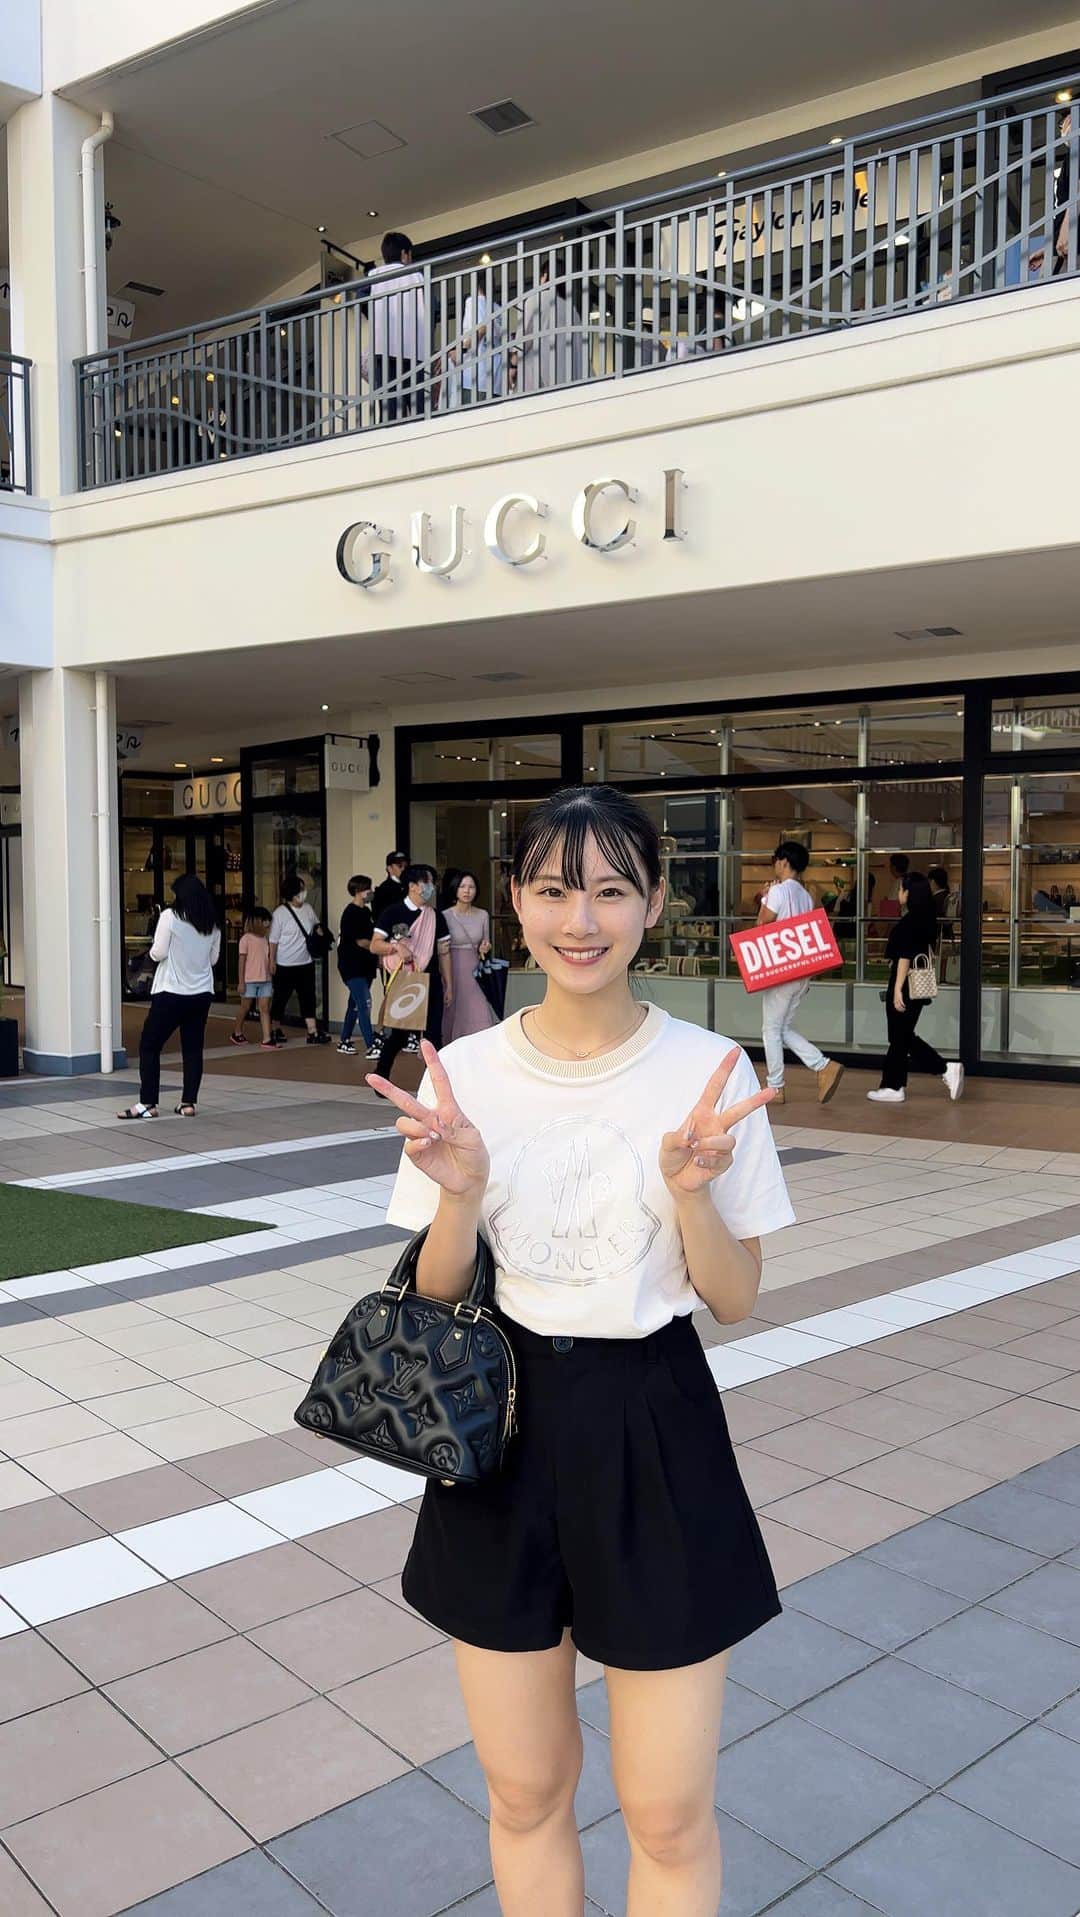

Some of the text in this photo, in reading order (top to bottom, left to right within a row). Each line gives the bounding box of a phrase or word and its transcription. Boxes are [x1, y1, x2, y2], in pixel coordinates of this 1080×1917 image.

[336, 468, 685, 588] GUCCI
[182, 779, 242, 810] GUCC
[739, 920, 831, 974] DIESEL
[501, 1217, 648, 1271] MONCLER
